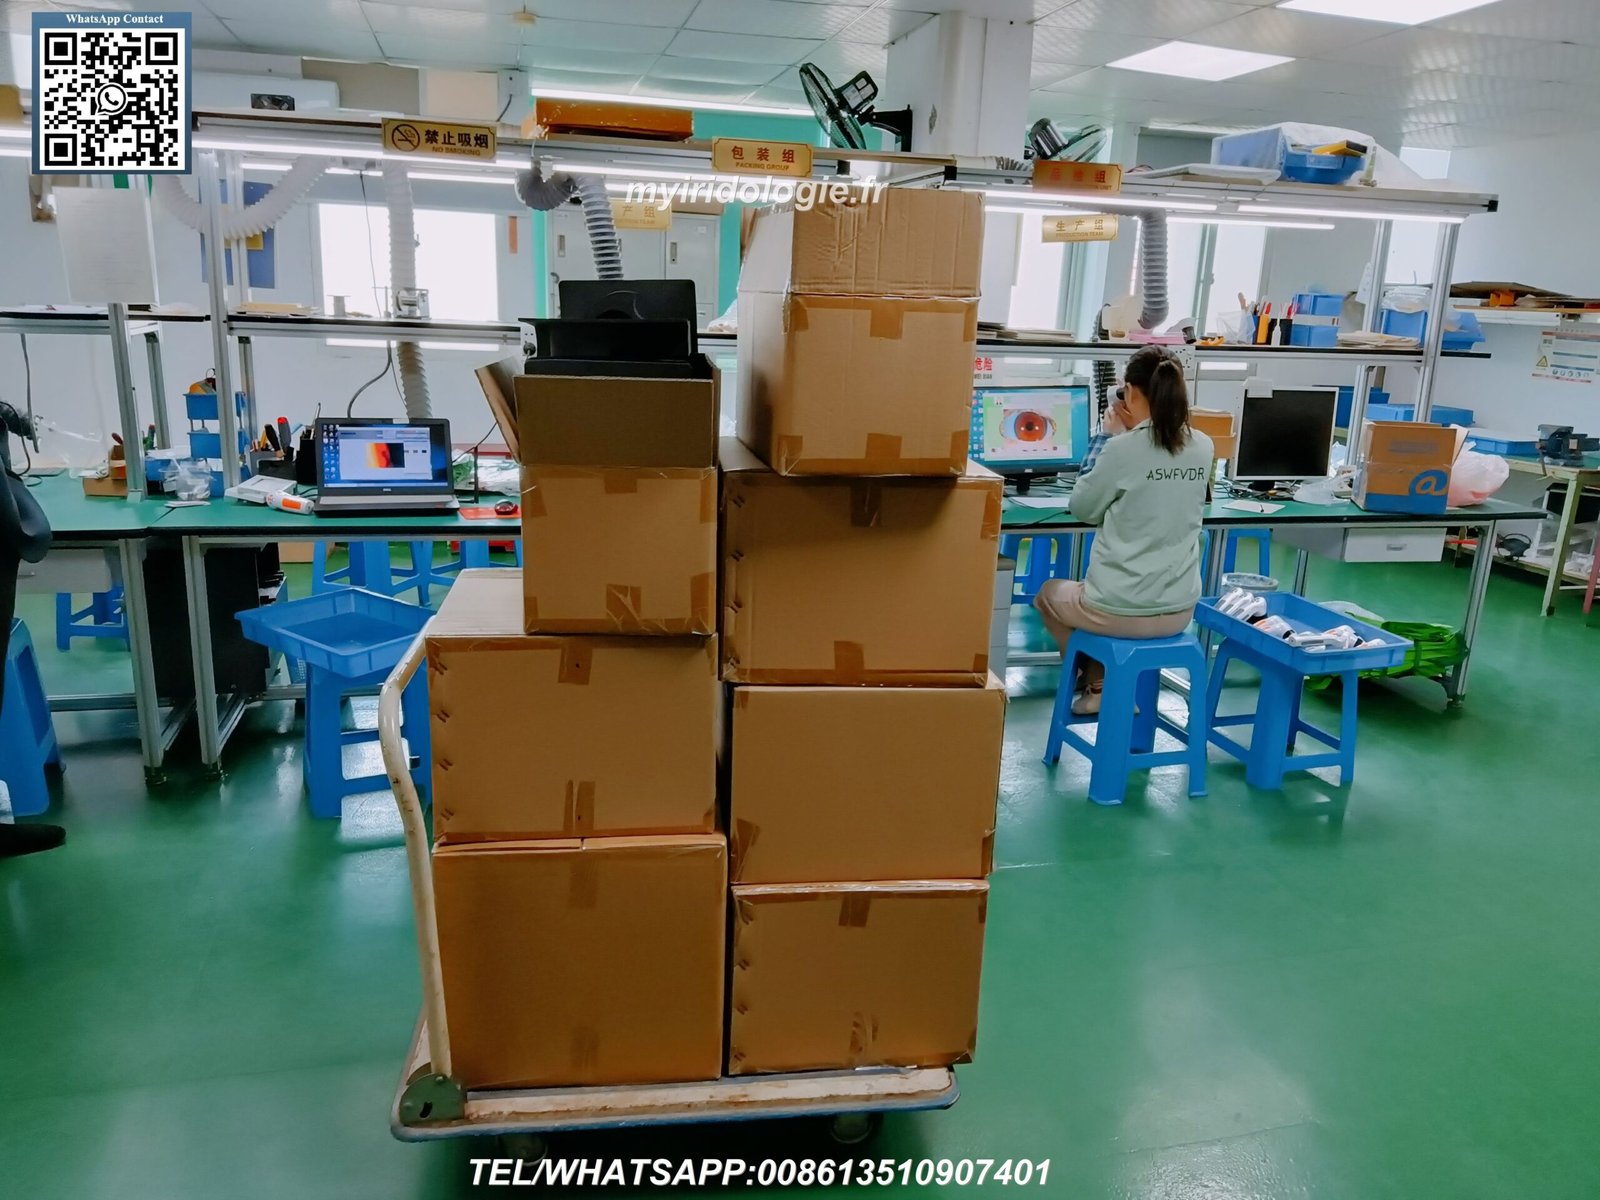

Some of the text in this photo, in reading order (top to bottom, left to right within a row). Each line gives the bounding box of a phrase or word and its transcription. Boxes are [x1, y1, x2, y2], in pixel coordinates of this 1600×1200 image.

[425, 129, 488, 149] 禁止吸烟
[445, 147, 480, 156] SMOKING
[731, 145, 795, 163] 包装组
[736, 161, 790, 171] PACKING GROUP
[622, 204, 656, 218] 产组
[1056, 219, 1104, 232] 生产组
[1145, 467, 1205, 481] ASWFVDR
